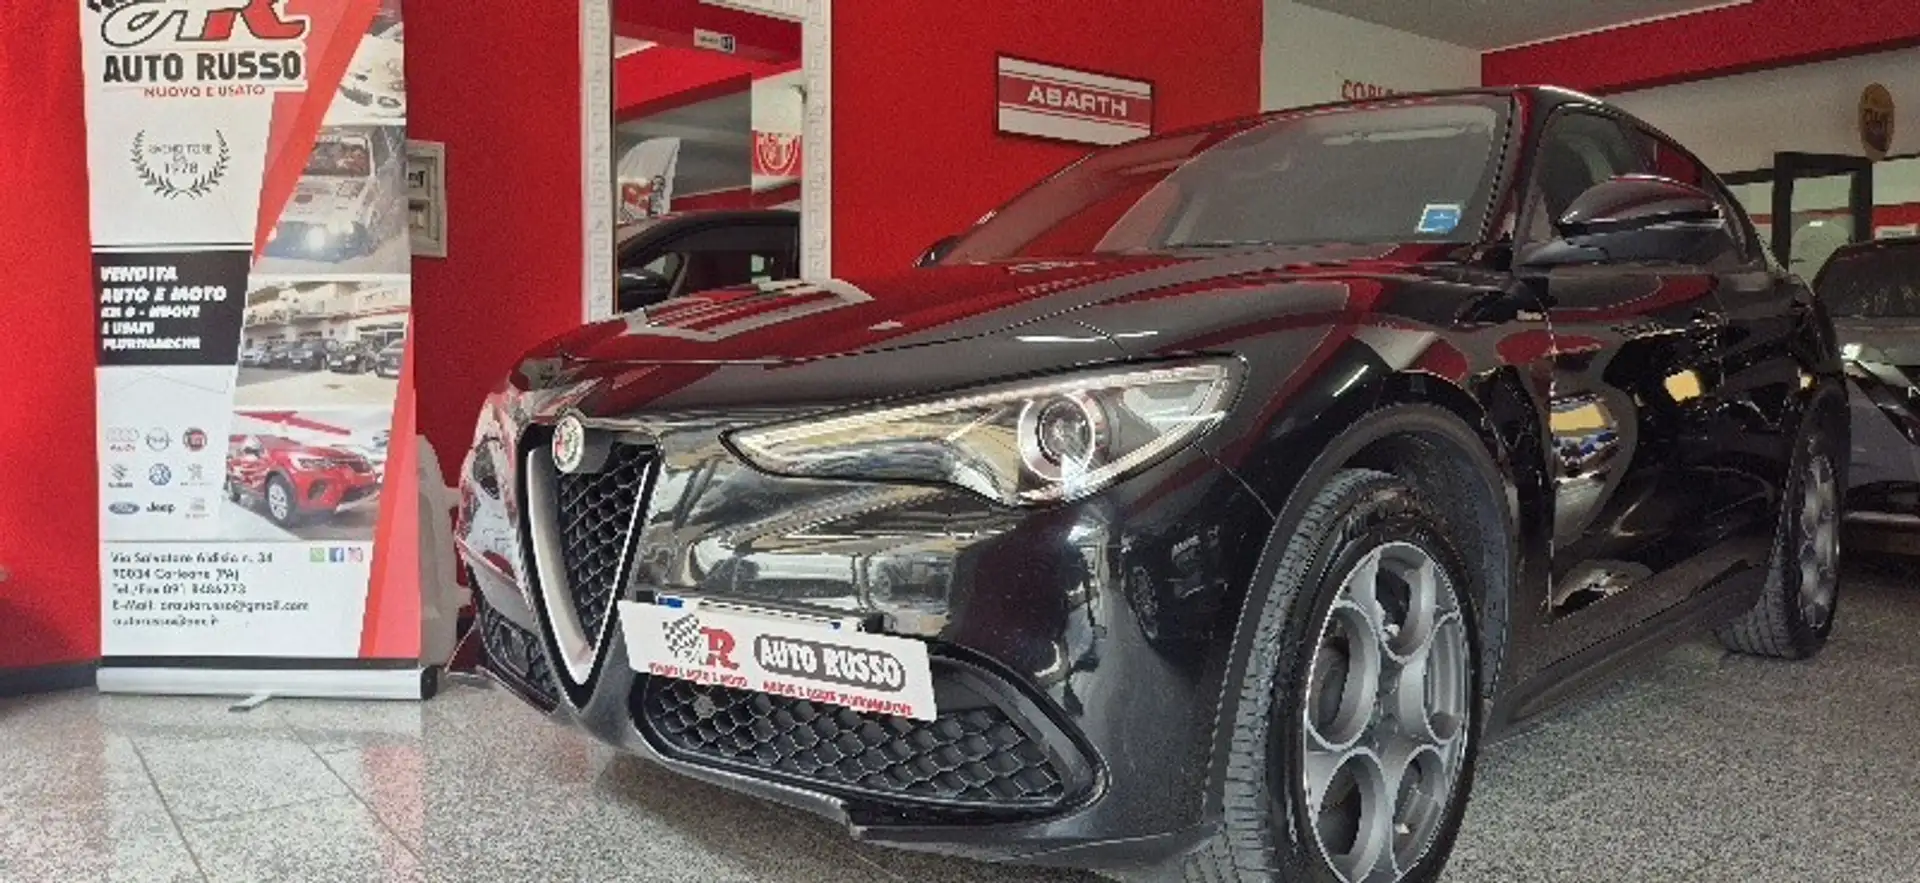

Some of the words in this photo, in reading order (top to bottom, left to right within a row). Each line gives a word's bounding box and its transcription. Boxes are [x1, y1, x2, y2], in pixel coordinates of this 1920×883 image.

[103, 53, 184, 83] AUTO
[196, 51, 301, 81] RUSSO
[144, 86, 201, 97] NUOVO
[205, 86, 214, 97] E
[218, 84, 266, 96] USATO
[1027, 84, 1128, 117] ABARTH
[100, 266, 179, 282] VENDITA
[101, 286, 150, 303] AUTO
[153, 286, 167, 302] E
[170, 284, 228, 302] MOTO
[146, 501, 177, 514] Jeep
[111, 551, 132, 563] Via
[760, 638, 818, 674] AUTO
[822, 647, 902, 689] RUSSO
